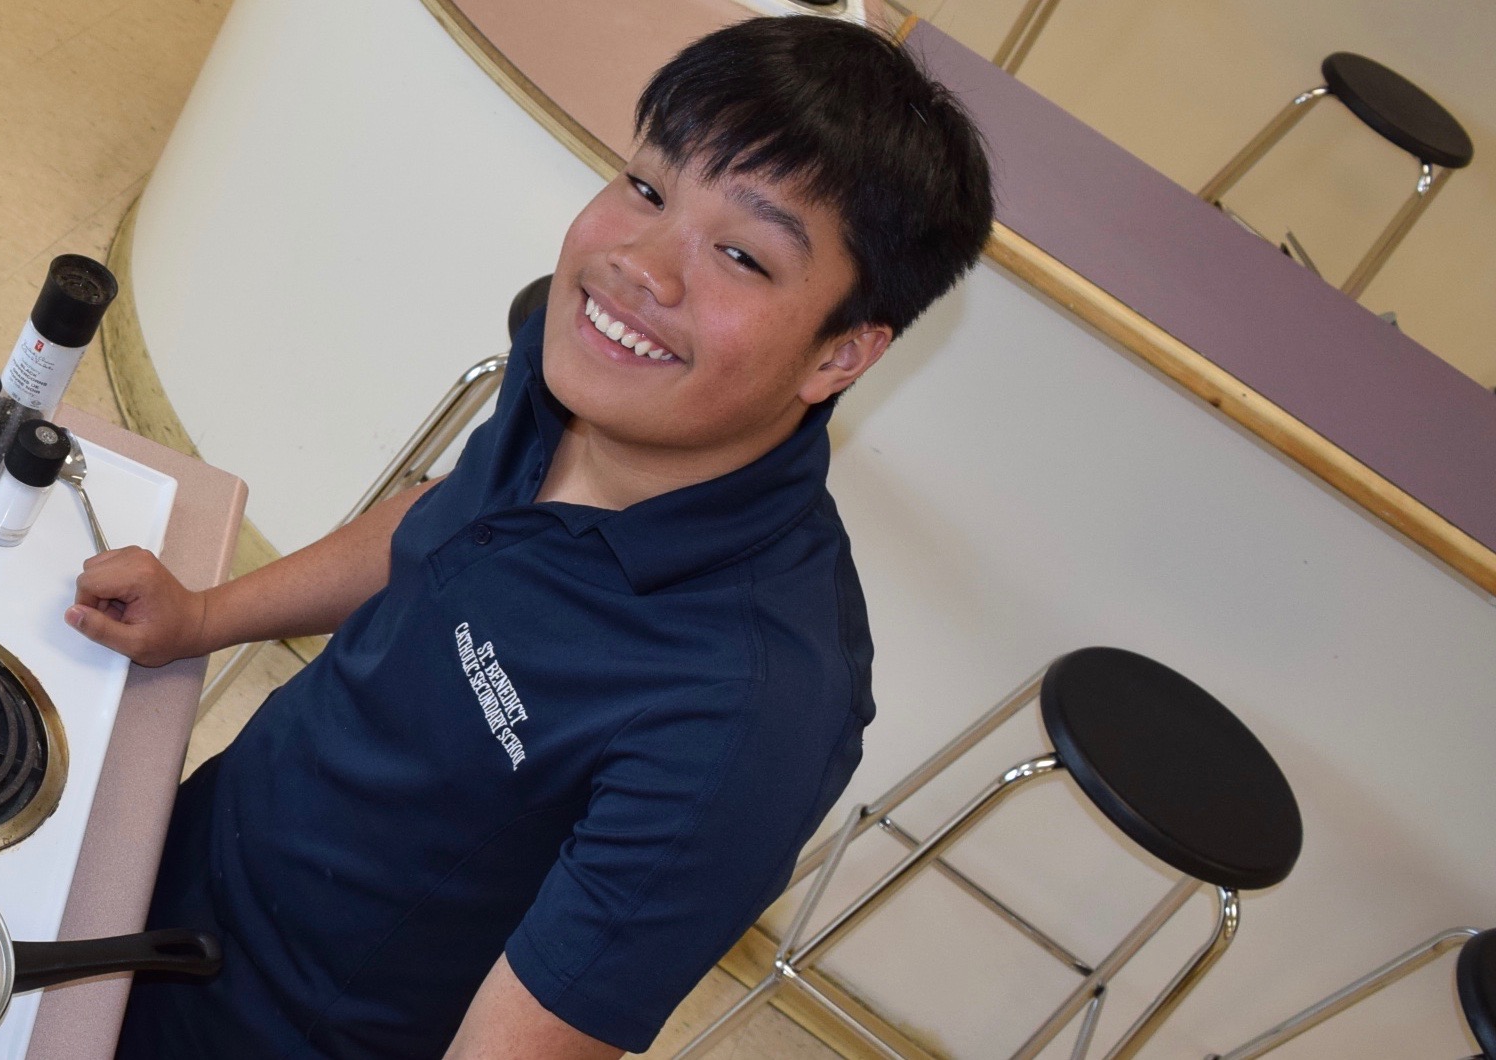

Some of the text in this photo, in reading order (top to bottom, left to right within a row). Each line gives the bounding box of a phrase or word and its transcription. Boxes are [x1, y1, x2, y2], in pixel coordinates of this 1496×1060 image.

[455, 622, 526, 771] CATHOLIC SECONDARY SCHOOL
[477, 641, 529, 728] ST. BENEDICT
